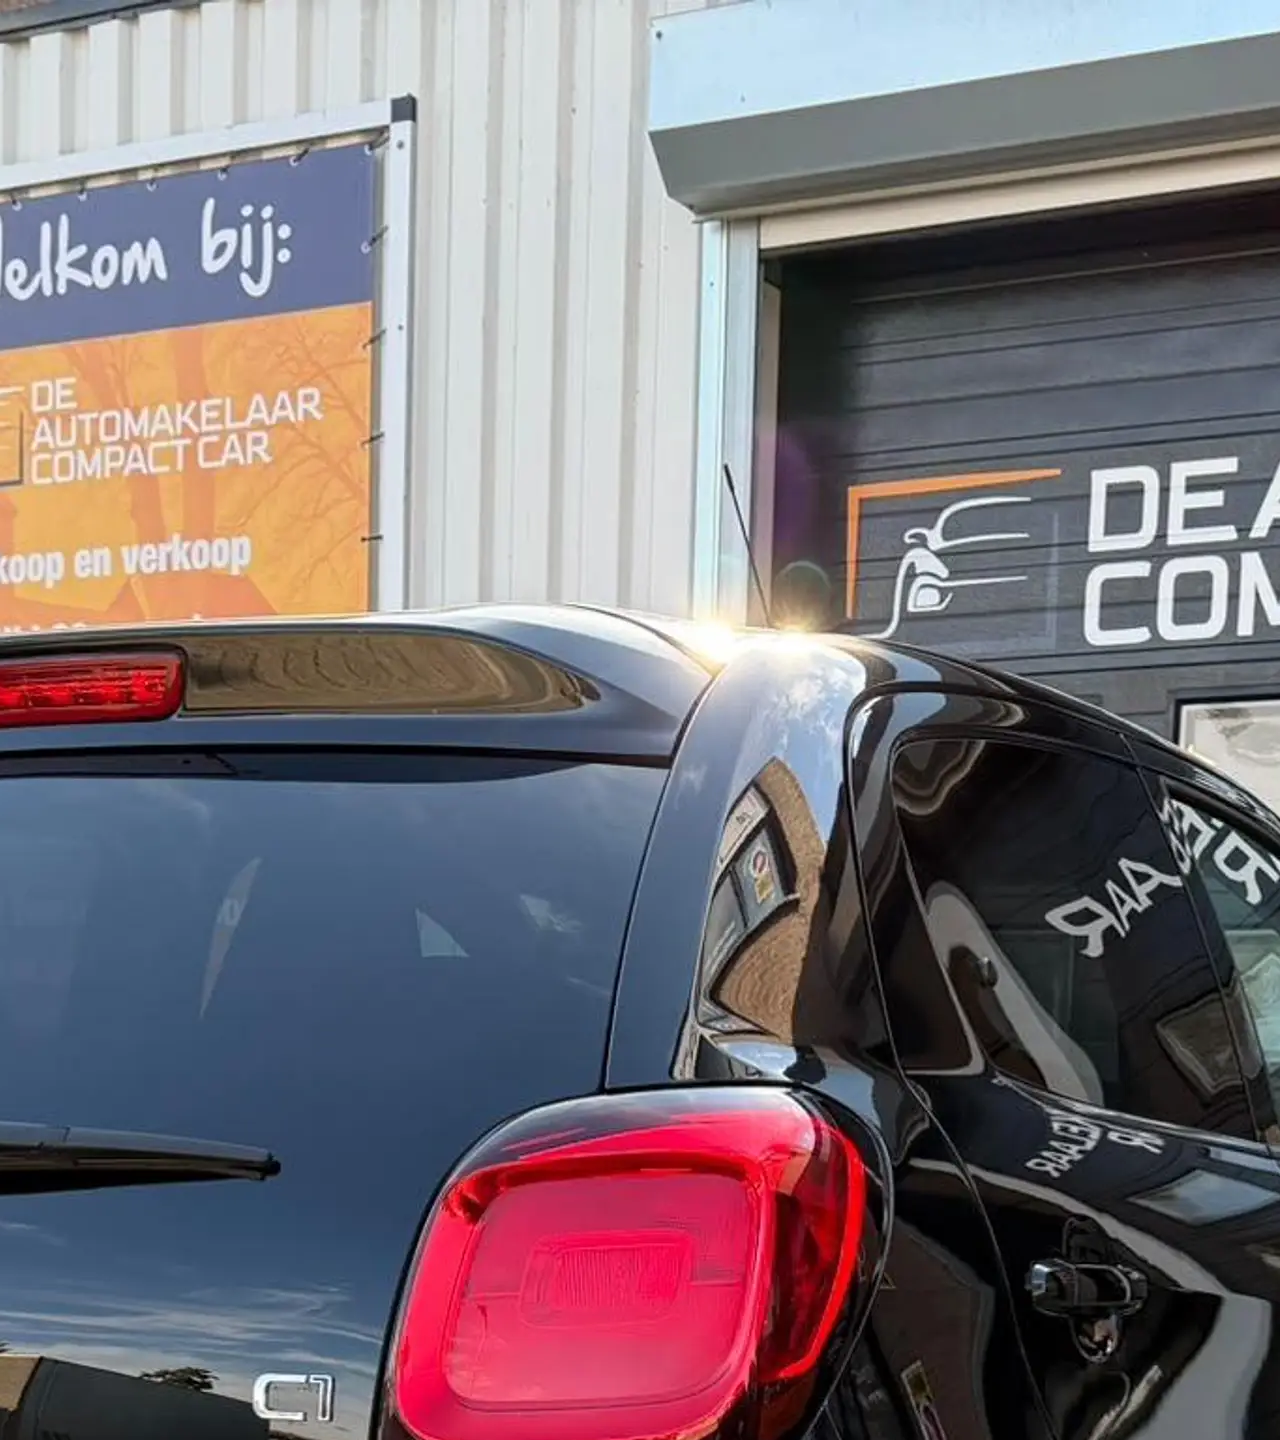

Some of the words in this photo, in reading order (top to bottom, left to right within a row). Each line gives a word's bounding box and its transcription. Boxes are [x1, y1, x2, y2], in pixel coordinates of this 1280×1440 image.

[202, 197, 291, 297] bij:
[30, 387, 324, 451] AUTOMAKELAAR
[31, 377, 78, 413] DE
[30, 438, 191, 485] COMPACT
[197, 431, 273, 469] CAR
[1087, 456, 1240, 552] DE
[73, 544, 113, 579] en
[121, 531, 253, 576] verkoop
